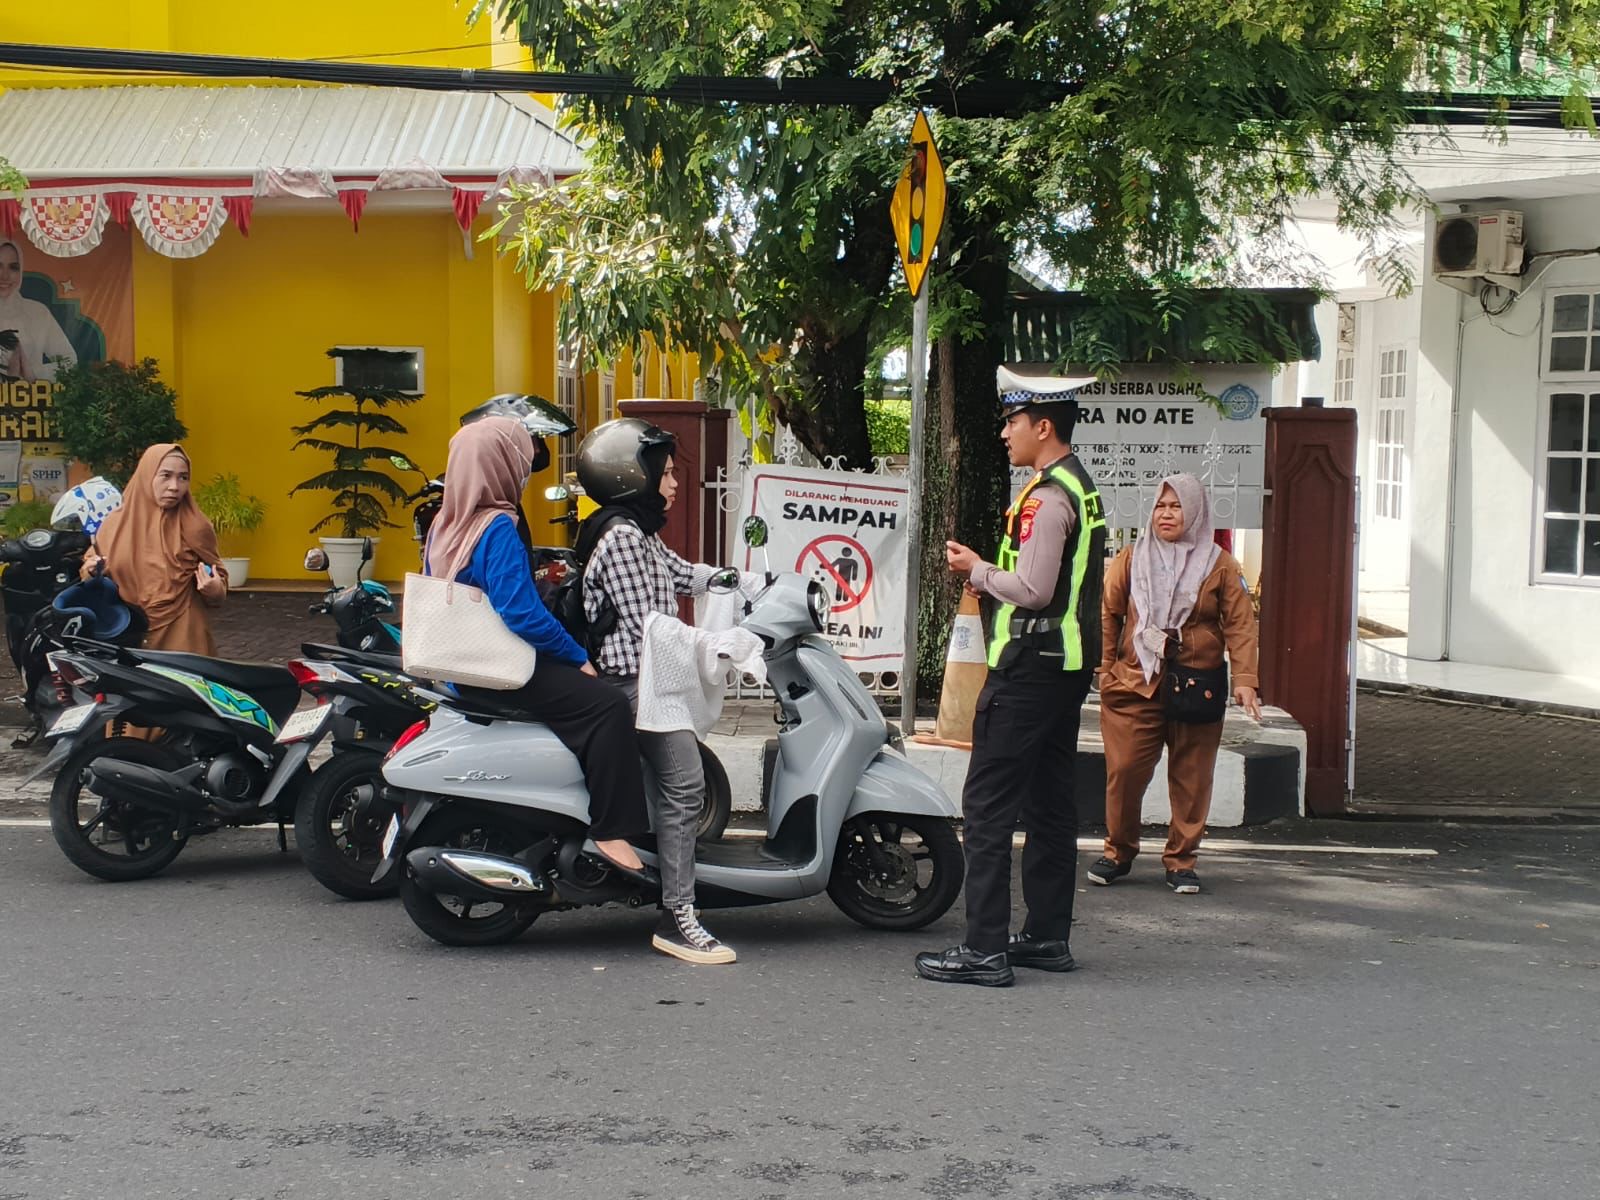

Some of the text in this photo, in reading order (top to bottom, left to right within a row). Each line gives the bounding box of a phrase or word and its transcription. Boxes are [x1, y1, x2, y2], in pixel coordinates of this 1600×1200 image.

[1110, 382, 1154, 395] SERBA
[1158, 382, 1204, 395] USAHA
[1116, 407, 1147, 424] NO
[1153, 408, 1194, 425] ATE
[32, 469, 62, 479] SPHP
[784, 489, 899, 507] DILARANG MEMBUANG
[782, 502, 897, 529] SAMPAH
[858, 625, 883, 639] INI
